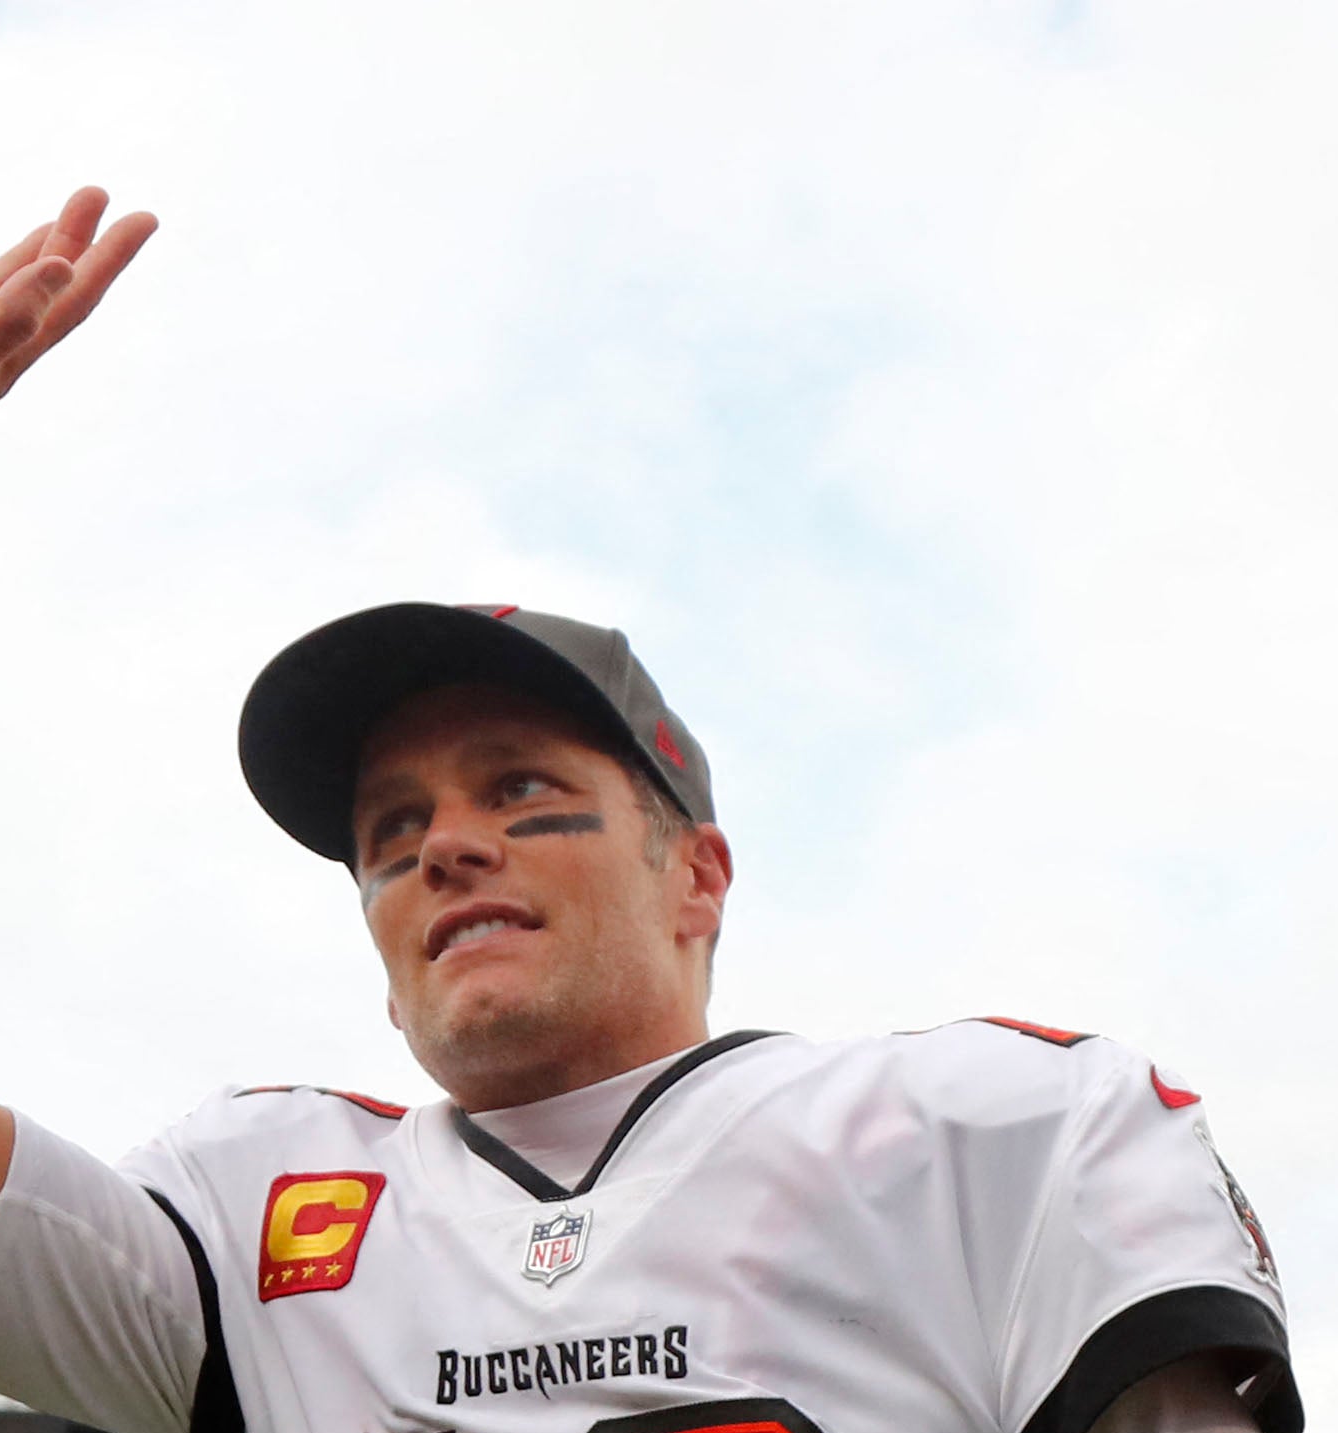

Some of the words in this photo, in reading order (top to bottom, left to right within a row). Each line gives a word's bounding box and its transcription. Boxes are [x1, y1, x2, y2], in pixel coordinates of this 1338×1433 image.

[267, 1178, 369, 1262] C
[530, 1237, 575, 1269] NFL
[436, 1325, 688, 1405] BUCCANEERS
